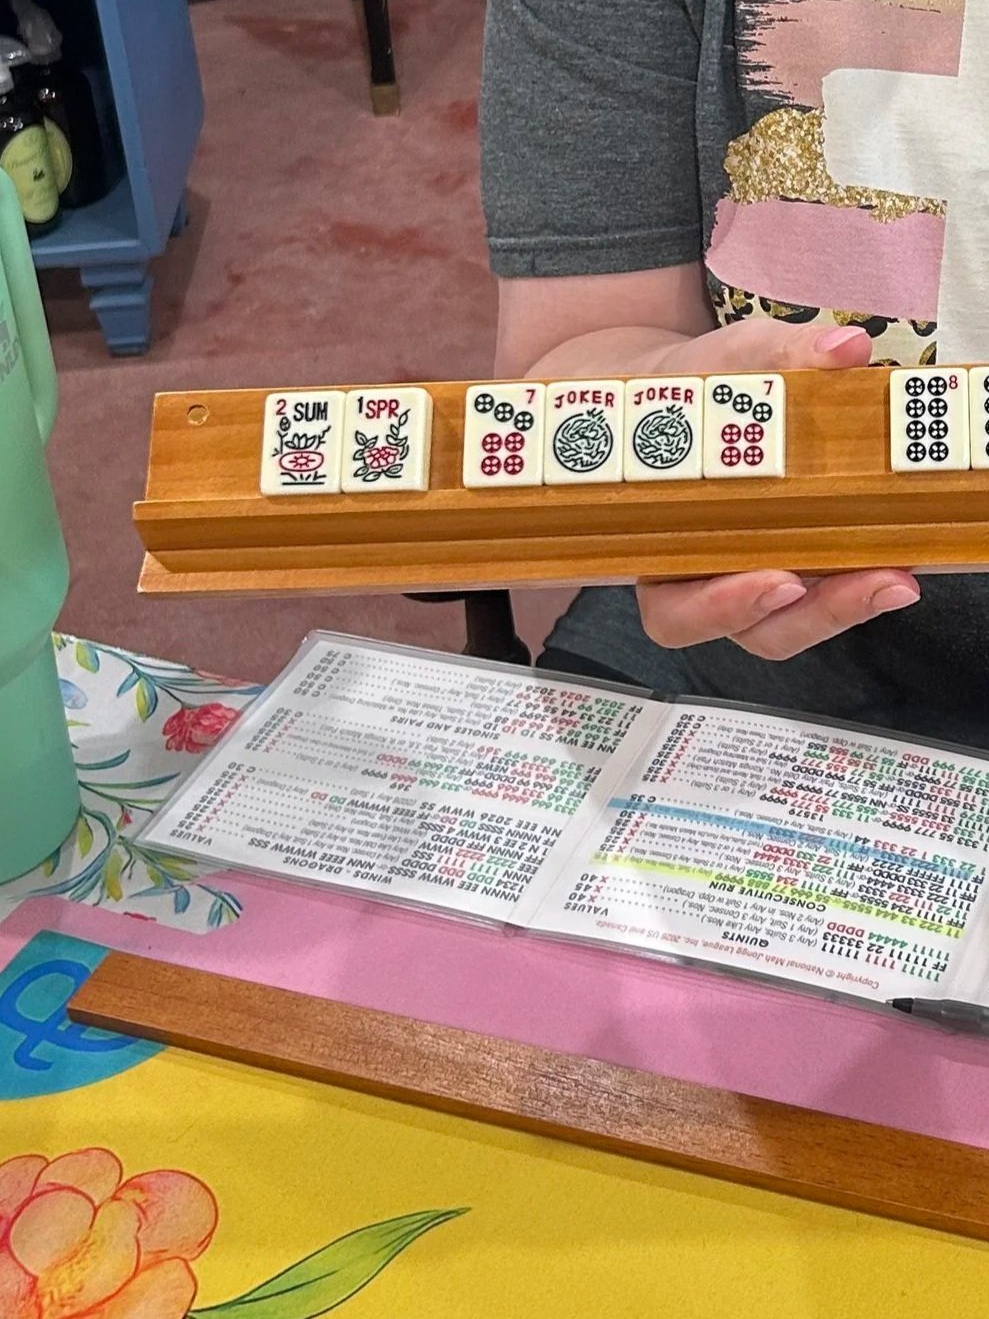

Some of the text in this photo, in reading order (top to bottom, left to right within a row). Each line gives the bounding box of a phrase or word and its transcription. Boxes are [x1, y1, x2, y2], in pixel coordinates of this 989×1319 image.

[764, 380, 774, 395] 7
[949, 375, 958, 389] 8
[526, 389, 536, 404] 7
[554, 390, 615, 409] JOKER
[634, 386, 694, 406] JOKER
[276, 399, 328, 421] 2 SUM
[357, 397, 400, 419] 1 SPR
[387, 713, 501, 742] SINGLES AND PAIRS
[786, 806, 826, 822] 13579
[166, 827, 216, 846] VALUES
[279, 853, 343, 875] DRAGONS
[349, 867, 395, 885] WINDS
[572, 880, 594, 893] 45
[706, 878, 828, 914] CONSECUTIVE RUN
[561, 898, 611, 918] VALUES
[747, 912, 768, 924] Any
[697, 937, 736, 954] League,
[719, 929, 771, 949] QUINTS
[819, 930, 865, 949] 33333
[865, 942, 885, 954] 22
[734, 946, 765, 961] Jongg
[762, 953, 786, 967] Mah
[886, 948, 930, 967] 11111
[784, 958, 825, 976] National
[930, 960, 948, 972] FF
[833, 969, 881, 990] Copyright
